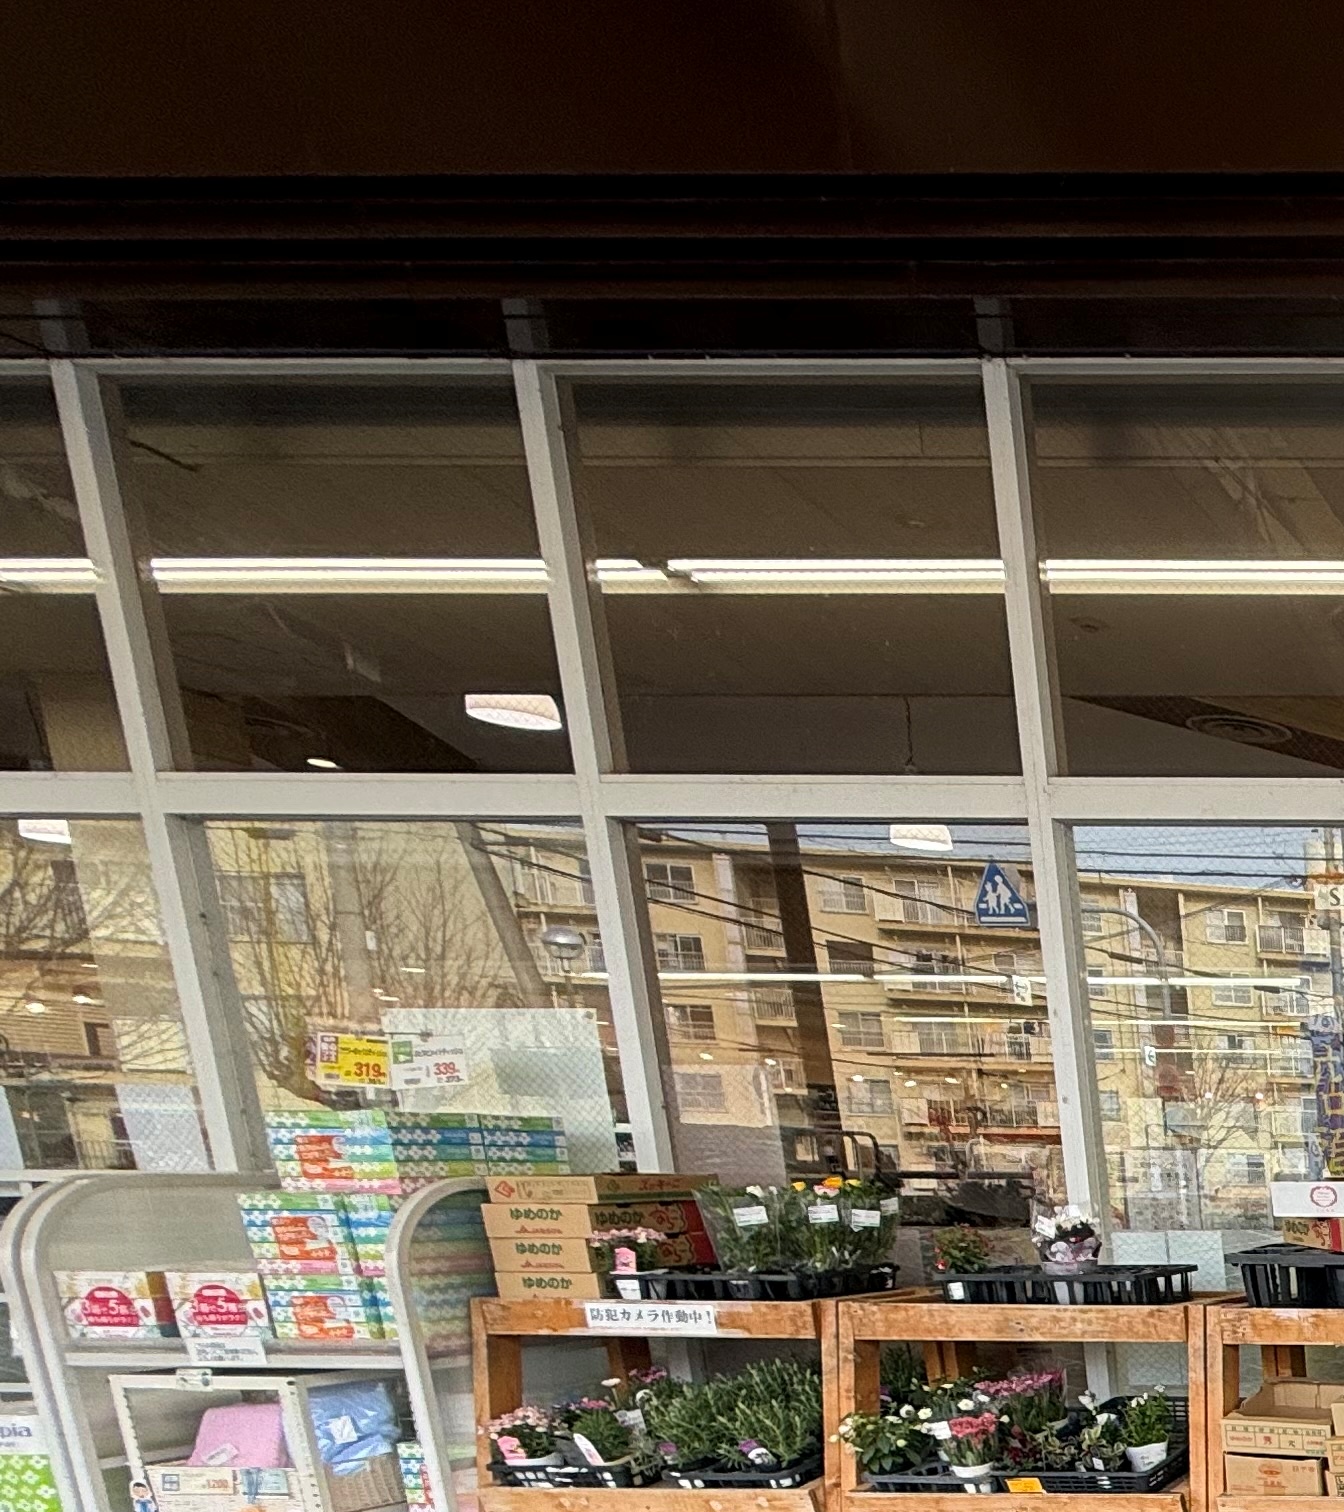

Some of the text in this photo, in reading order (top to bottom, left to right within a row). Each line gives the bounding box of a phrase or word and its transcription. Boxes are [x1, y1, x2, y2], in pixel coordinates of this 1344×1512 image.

[511, 1208, 563, 1221] ゆめのか
[594, 1210, 645, 1224] ゆめのか
[515, 1243, 563, 1255] ゆめのか
[522, 1277, 572, 1289] ゆめのか
[590, 1307, 712, 1324] 防犯カメラ作動中！
